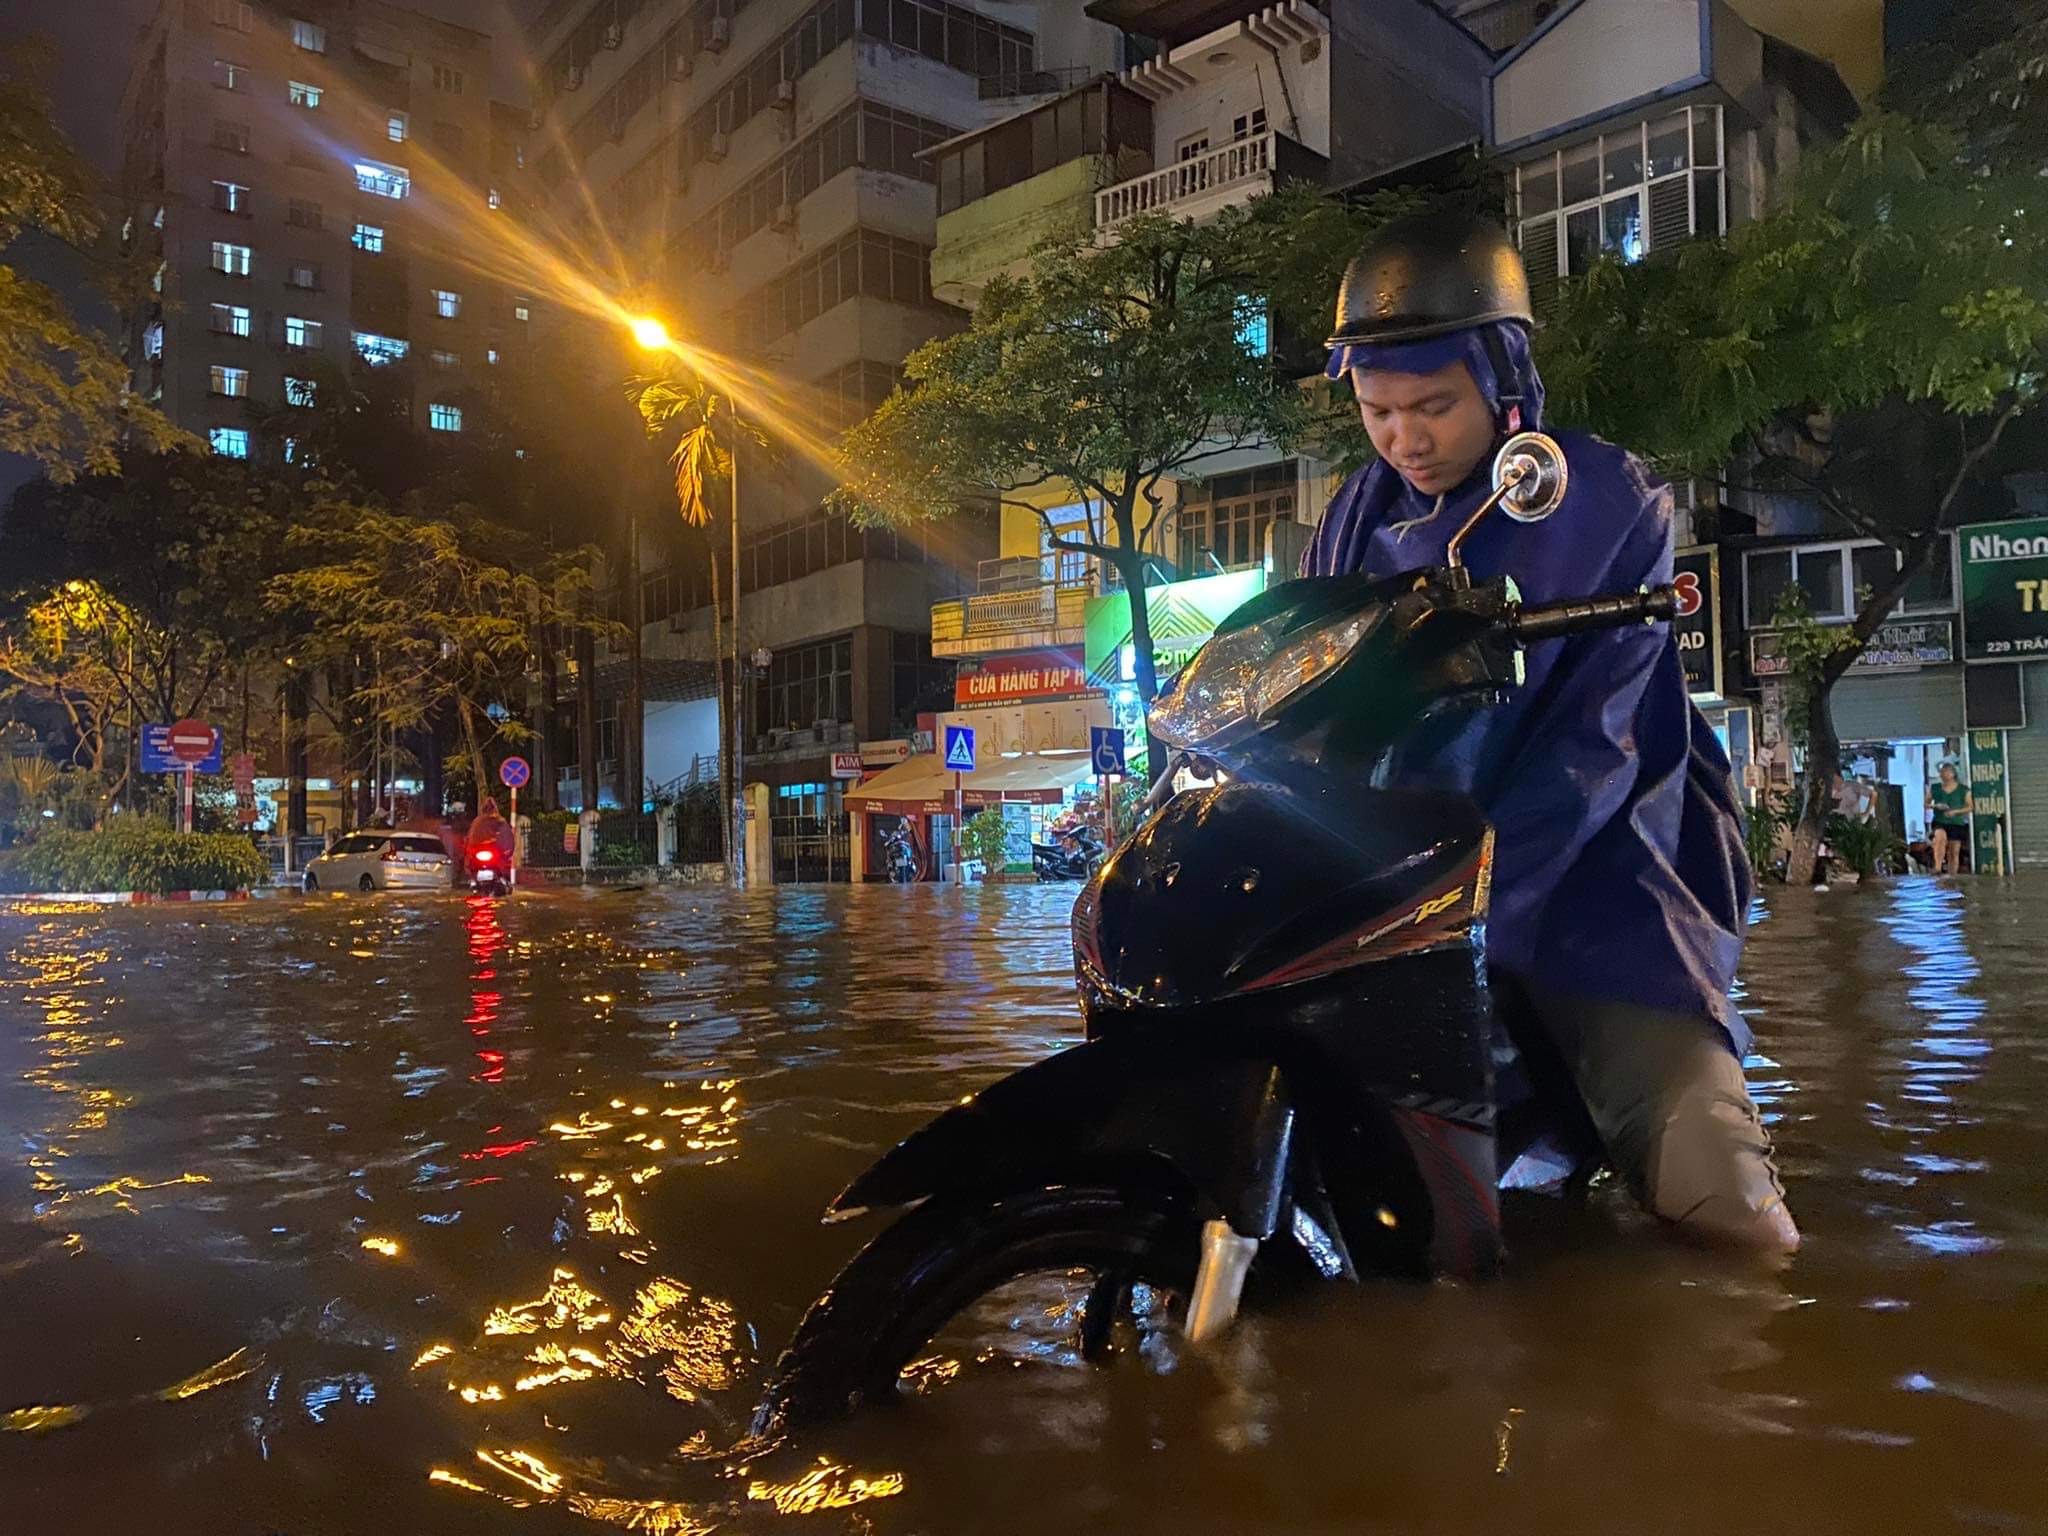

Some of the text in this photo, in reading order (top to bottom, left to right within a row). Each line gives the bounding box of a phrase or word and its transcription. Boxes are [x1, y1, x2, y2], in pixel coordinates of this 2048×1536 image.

[1675, 631, 1705, 650] AD
[1986, 640, 2011, 652] 229
[969, 668, 996, 695] CỬA
[1000, 667, 1039, 692] HÀNG
[1043, 666, 1070, 691] TẠP
[837, 756, 860, 768] ATM
